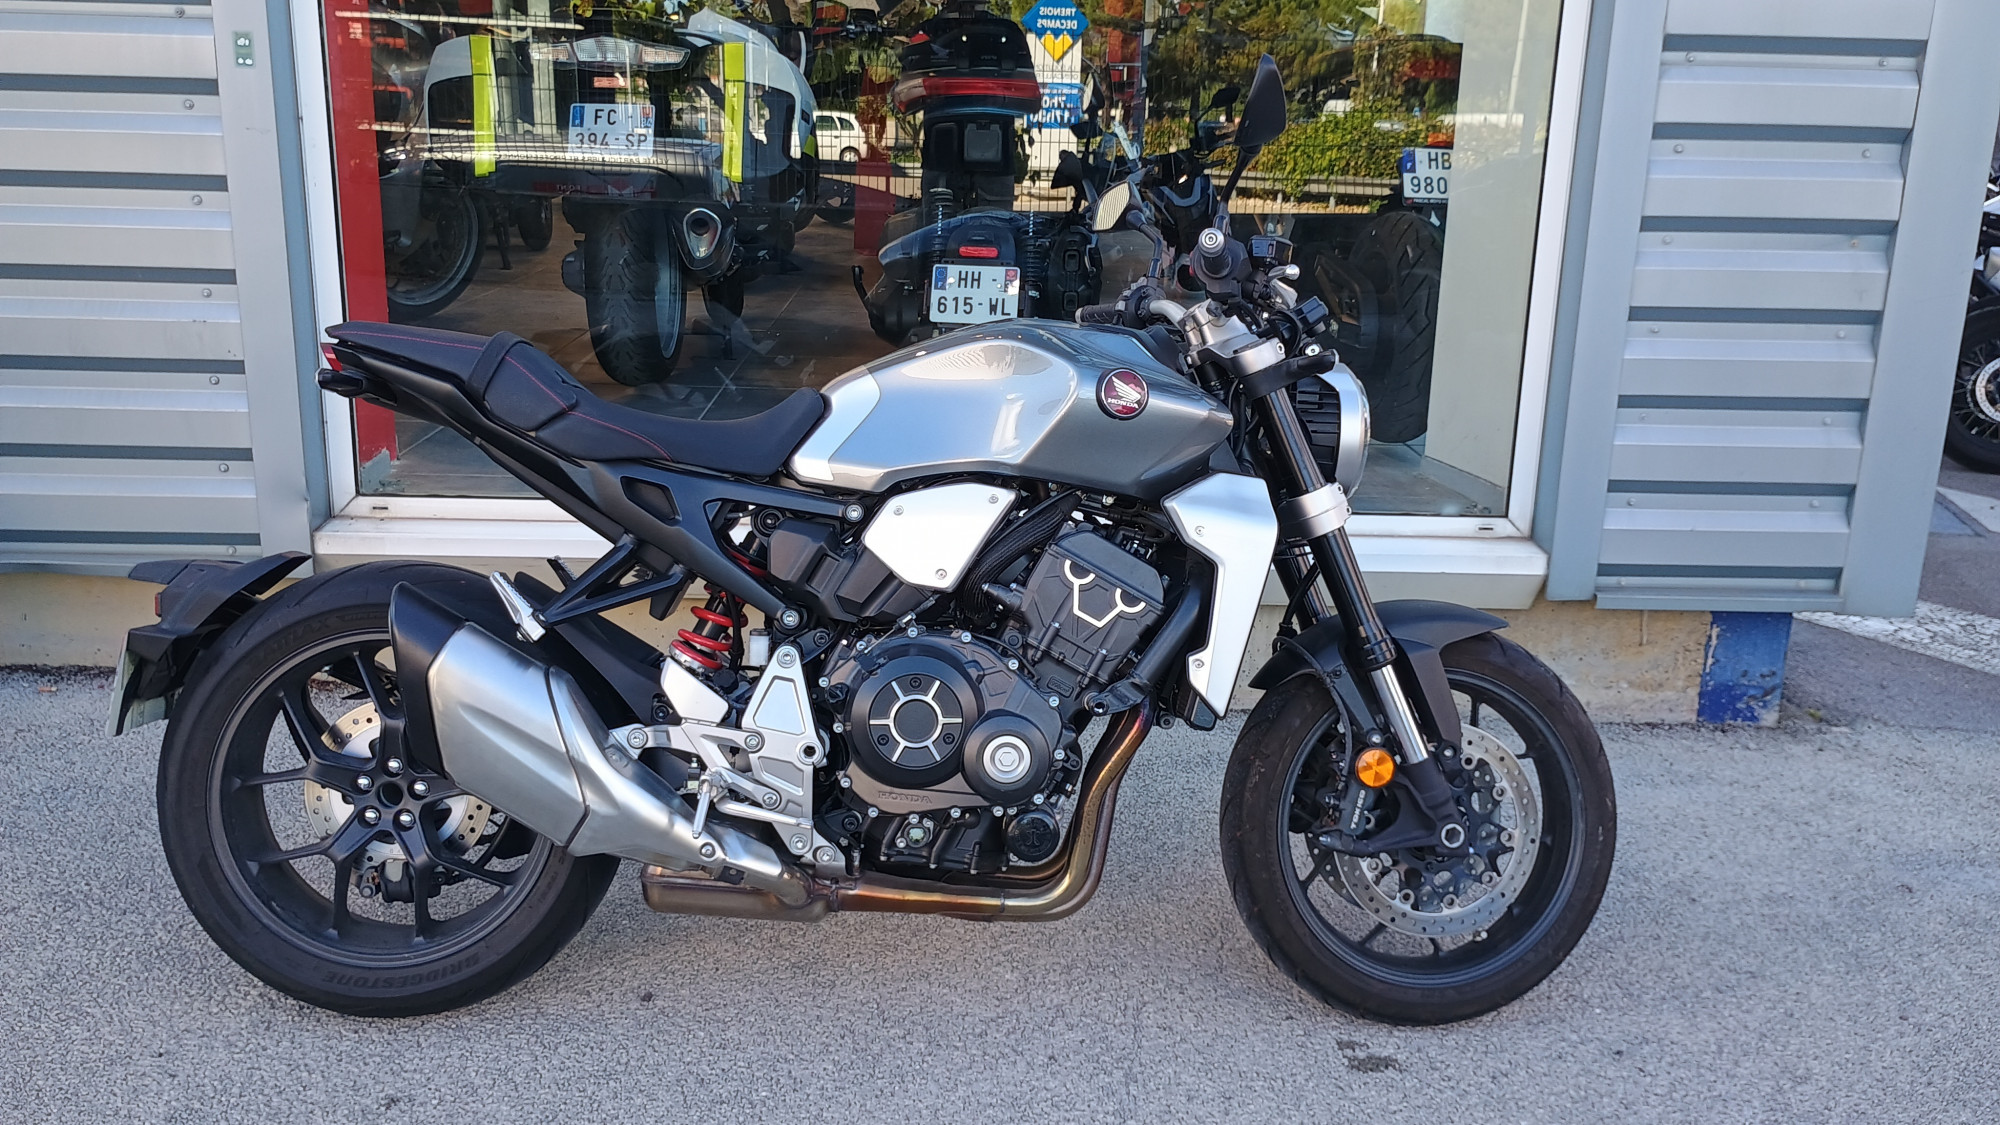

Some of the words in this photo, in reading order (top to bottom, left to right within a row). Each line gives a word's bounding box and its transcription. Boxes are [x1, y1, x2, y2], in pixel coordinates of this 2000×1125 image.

[594, 109, 617, 125] FC
[1428, 152, 1452, 170] HB
[1410, 176, 1448, 194] 980
[958, 270, 981, 289] HH
[1107, 397, 1139, 409] HONDA
[878, 791, 932, 804] HONDA
[322, 952, 480, 989] BRIDGESTONE
